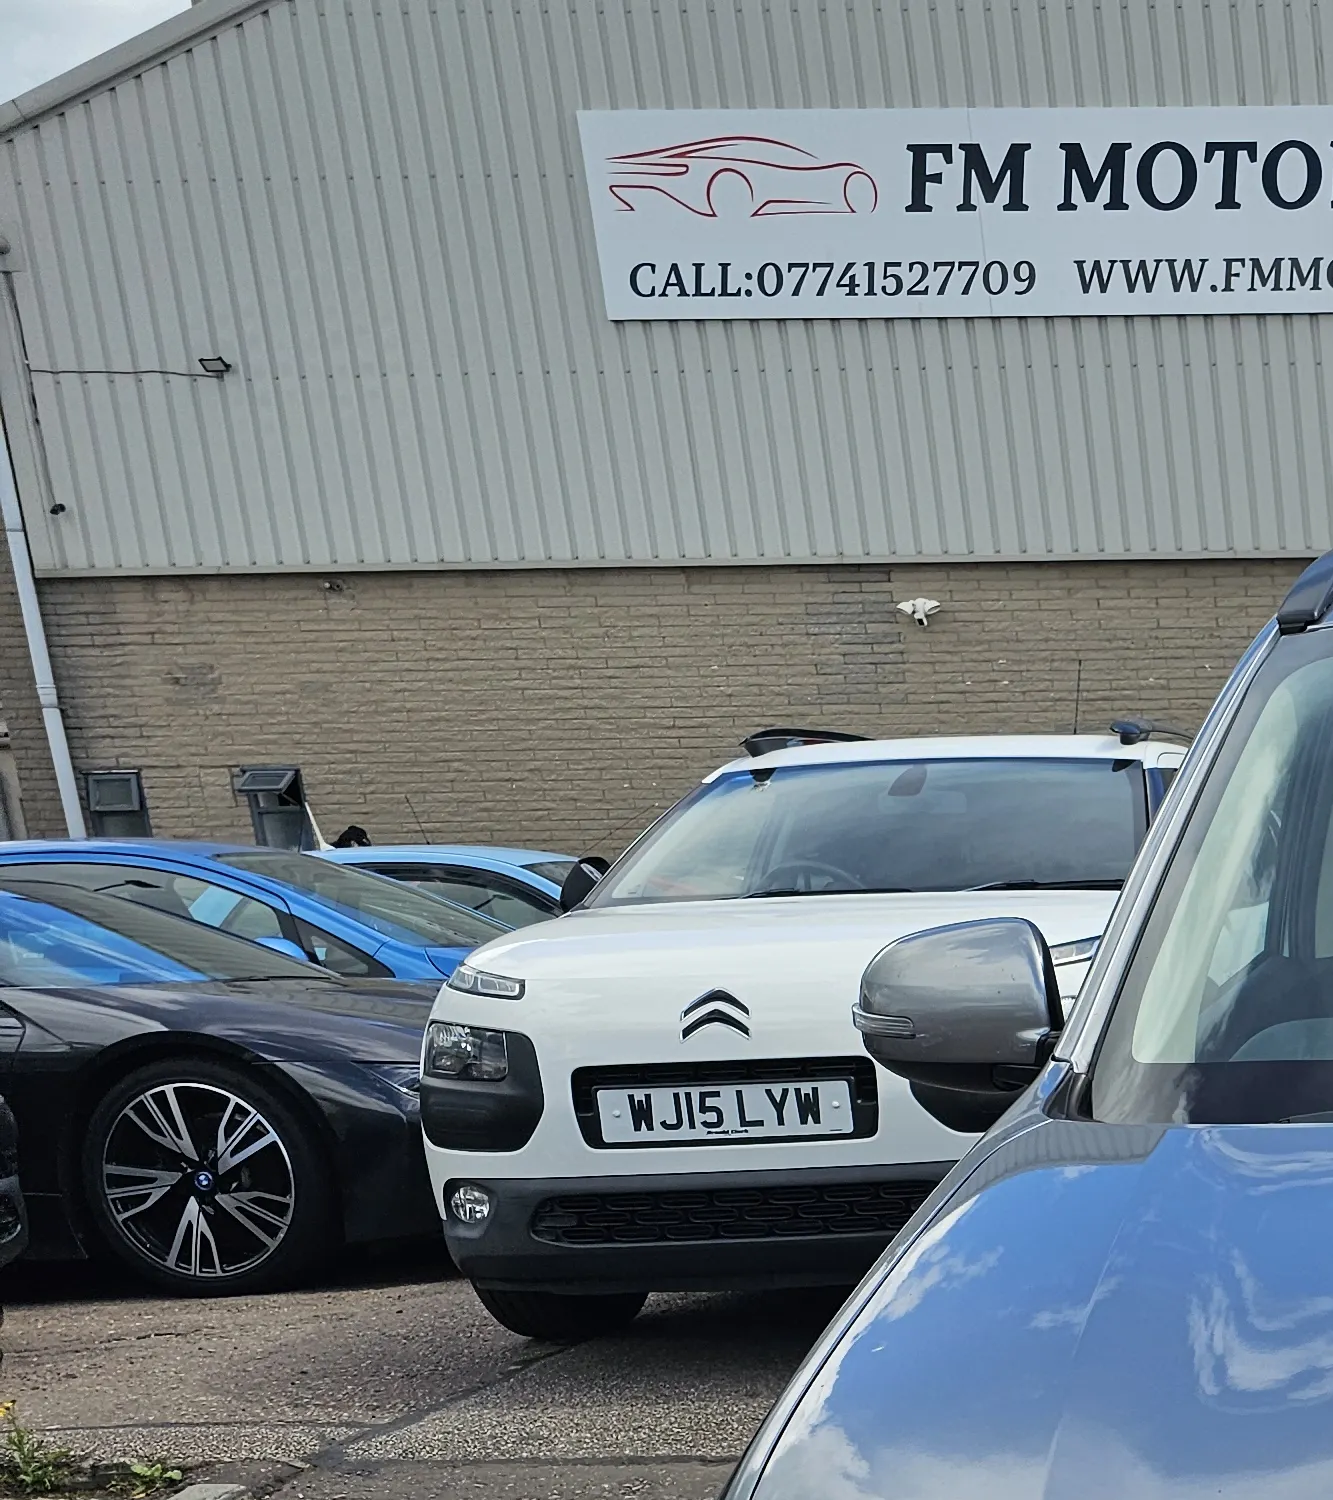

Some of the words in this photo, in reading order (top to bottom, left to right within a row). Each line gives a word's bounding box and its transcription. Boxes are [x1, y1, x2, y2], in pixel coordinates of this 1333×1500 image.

[904, 142, 1032, 213] FM
[629, 260, 1036, 298] CALL:07741527709
[627, 1090, 725, 1132] WJ15
[735, 1086, 822, 1128] LYW
